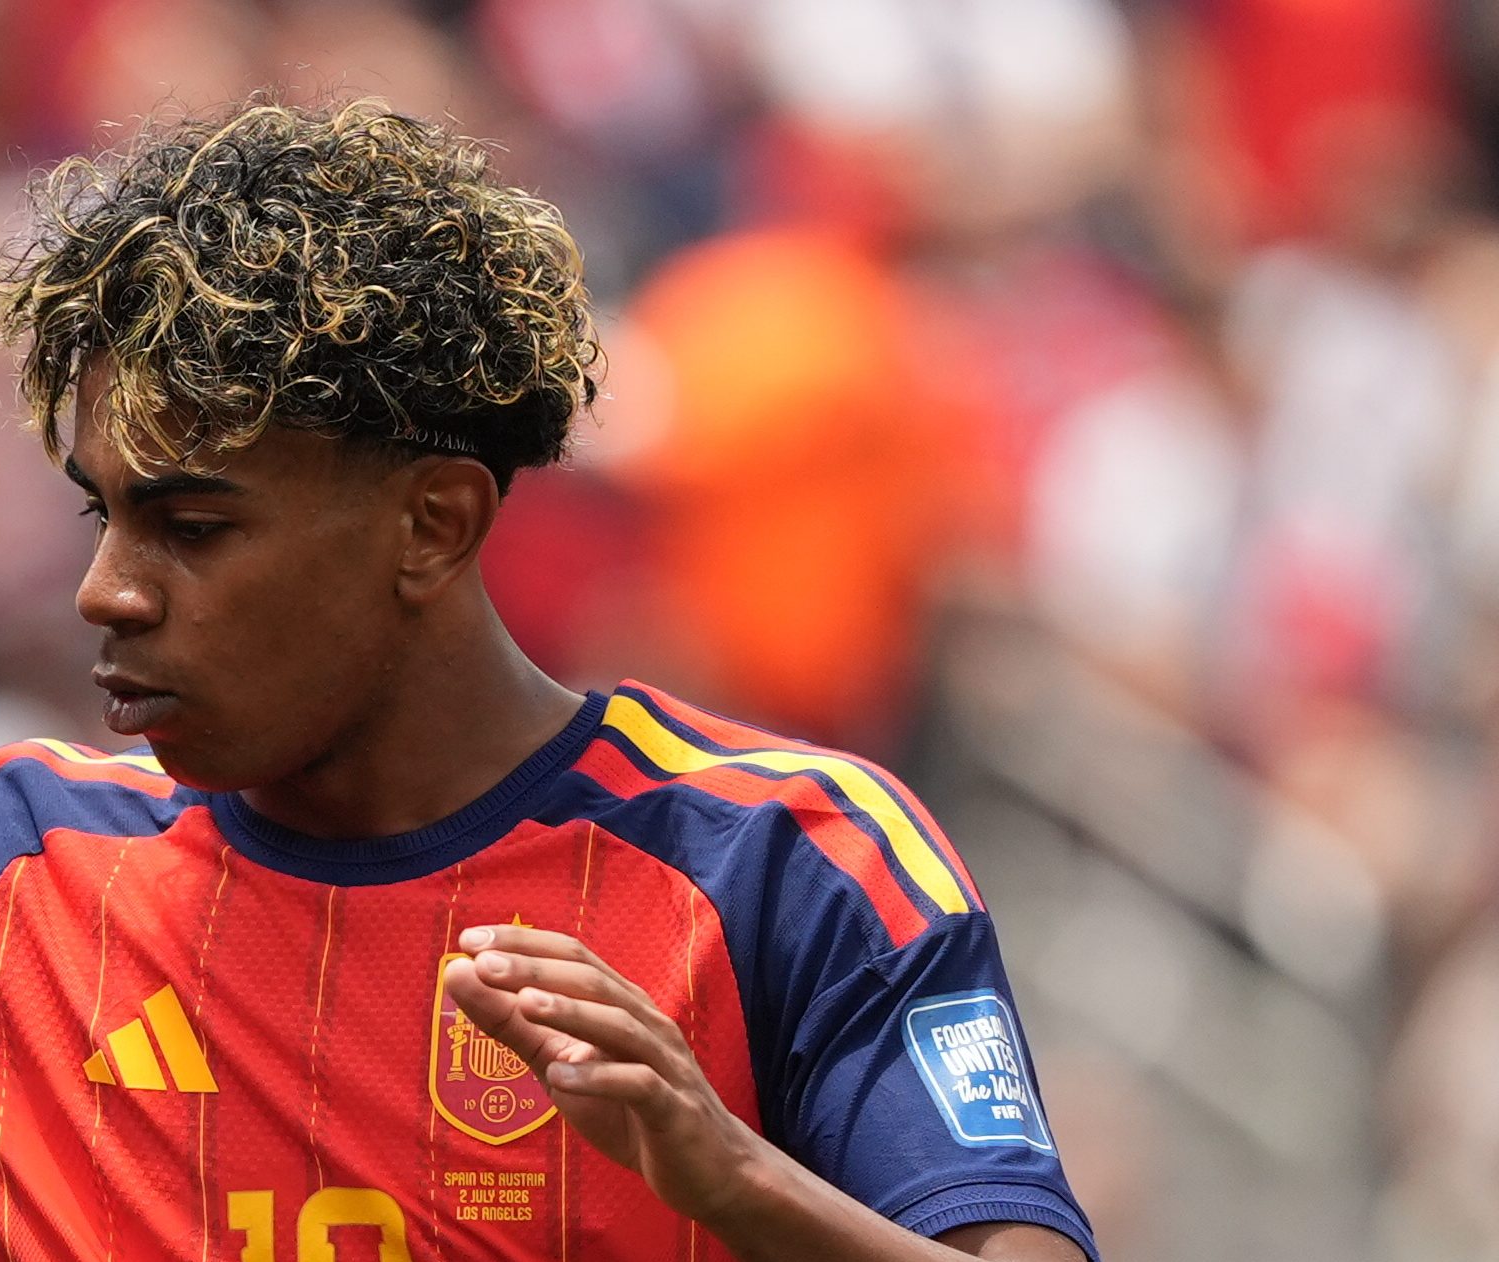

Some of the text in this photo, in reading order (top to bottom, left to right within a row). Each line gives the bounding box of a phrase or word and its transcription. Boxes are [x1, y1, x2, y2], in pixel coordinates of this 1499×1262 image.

[940, 1039, 1019, 1078] UNITES
[952, 1076, 992, 1104] the
[463, 1098, 535, 1111] 19 09
[444, 1172, 476, 1186] SPAIN
[498, 1173, 546, 1187] AUSTRIA
[459, 1189, 530, 1203] 2 JULY 2026
[456, 1206, 533, 1221] LOS ANGELES
